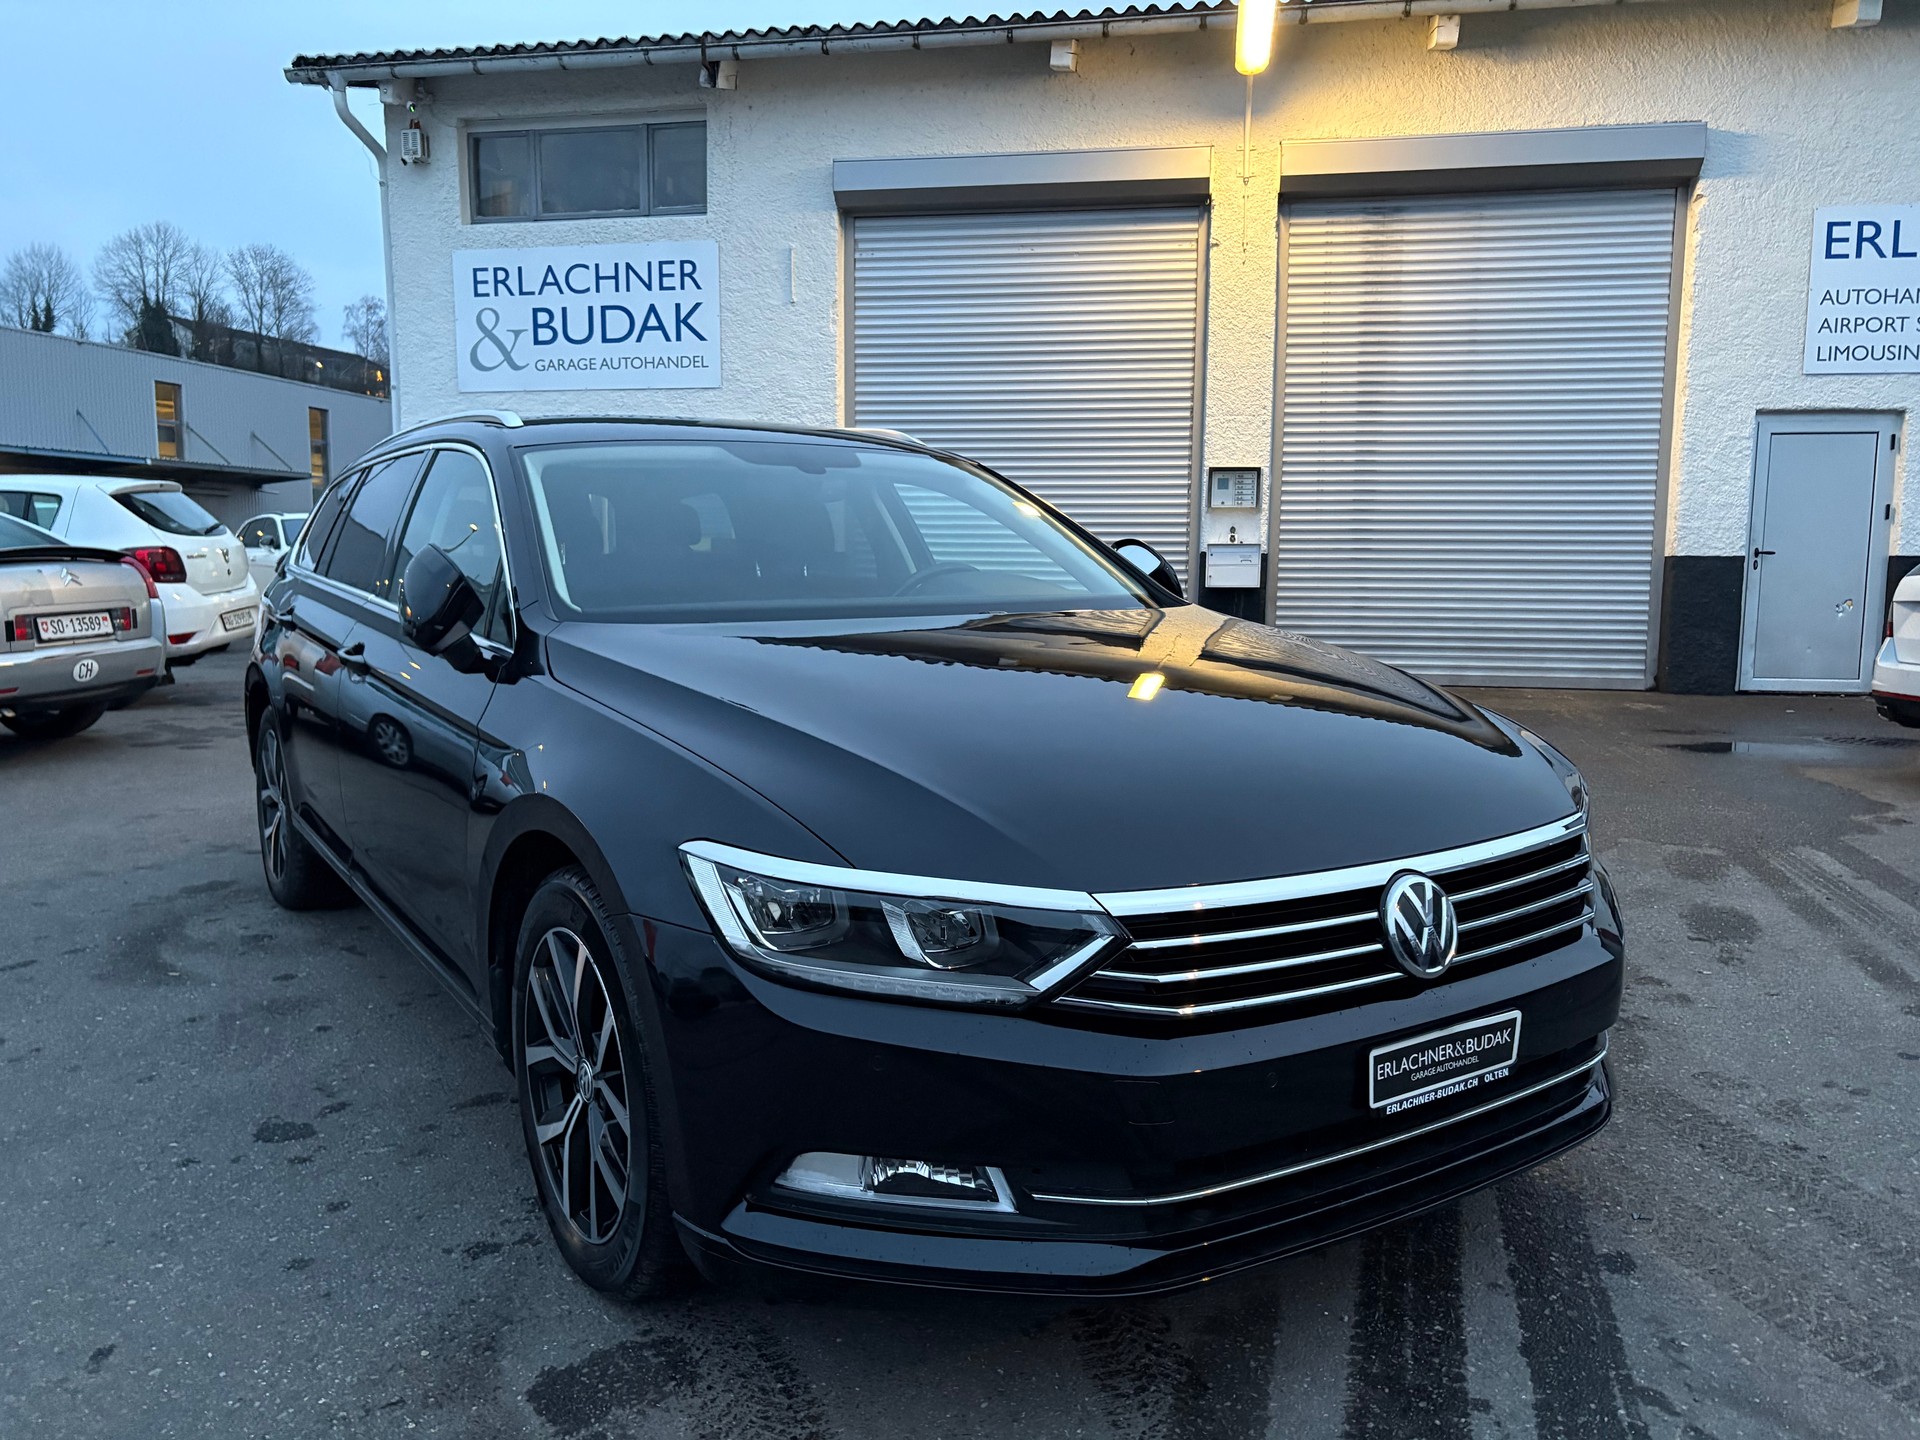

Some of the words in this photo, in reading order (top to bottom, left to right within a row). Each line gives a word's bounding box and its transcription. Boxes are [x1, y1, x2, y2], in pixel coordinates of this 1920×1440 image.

[1825, 219, 1918, 260] ERL
[472, 259, 703, 298] ERLACHNER
[1819, 287, 1920, 306] AUTOHA
[1817, 316, 1910, 334] AIRPORT
[469, 307, 530, 373] &
[531, 302, 709, 346] BUDAK
[534, 357, 597, 373] GARAGE
[599, 355, 709, 371] AUTOHANDEL
[1816, 344, 1920, 362] LIMOUSIN
[78, 662, 94, 679] CH
[1410, 1066, 1436, 1082] GARAGE
[1436, 1055, 1480, 1074] AUTOHANDEL
[1386, 1077, 1479, 1115] ERLACHNER-BUDAK.CH
[1484, 1067, 1510, 1083] OLTEN
